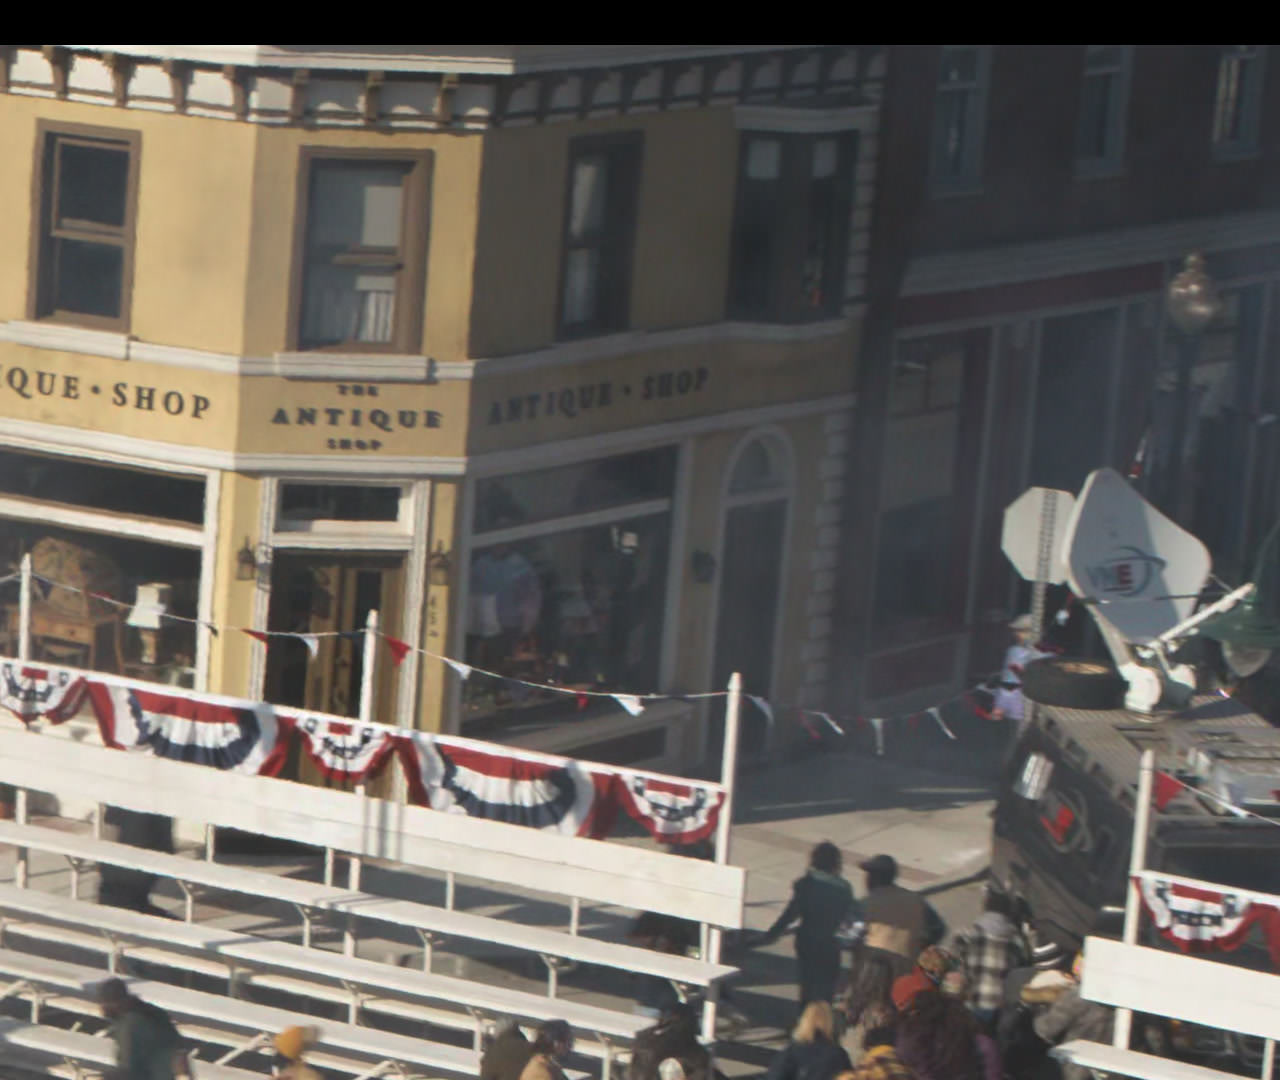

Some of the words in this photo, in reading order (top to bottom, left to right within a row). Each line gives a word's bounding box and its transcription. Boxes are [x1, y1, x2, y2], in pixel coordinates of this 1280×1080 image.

[111, 382, 211, 419] SHOP
[336, 384, 380, 397] THE
[488, 381, 613, 426] ANTIQUE
[643, 366, 709, 400] SHOP
[271, 407, 443, 432] ANTIQUE
[327, 438, 383, 451] SHOP
